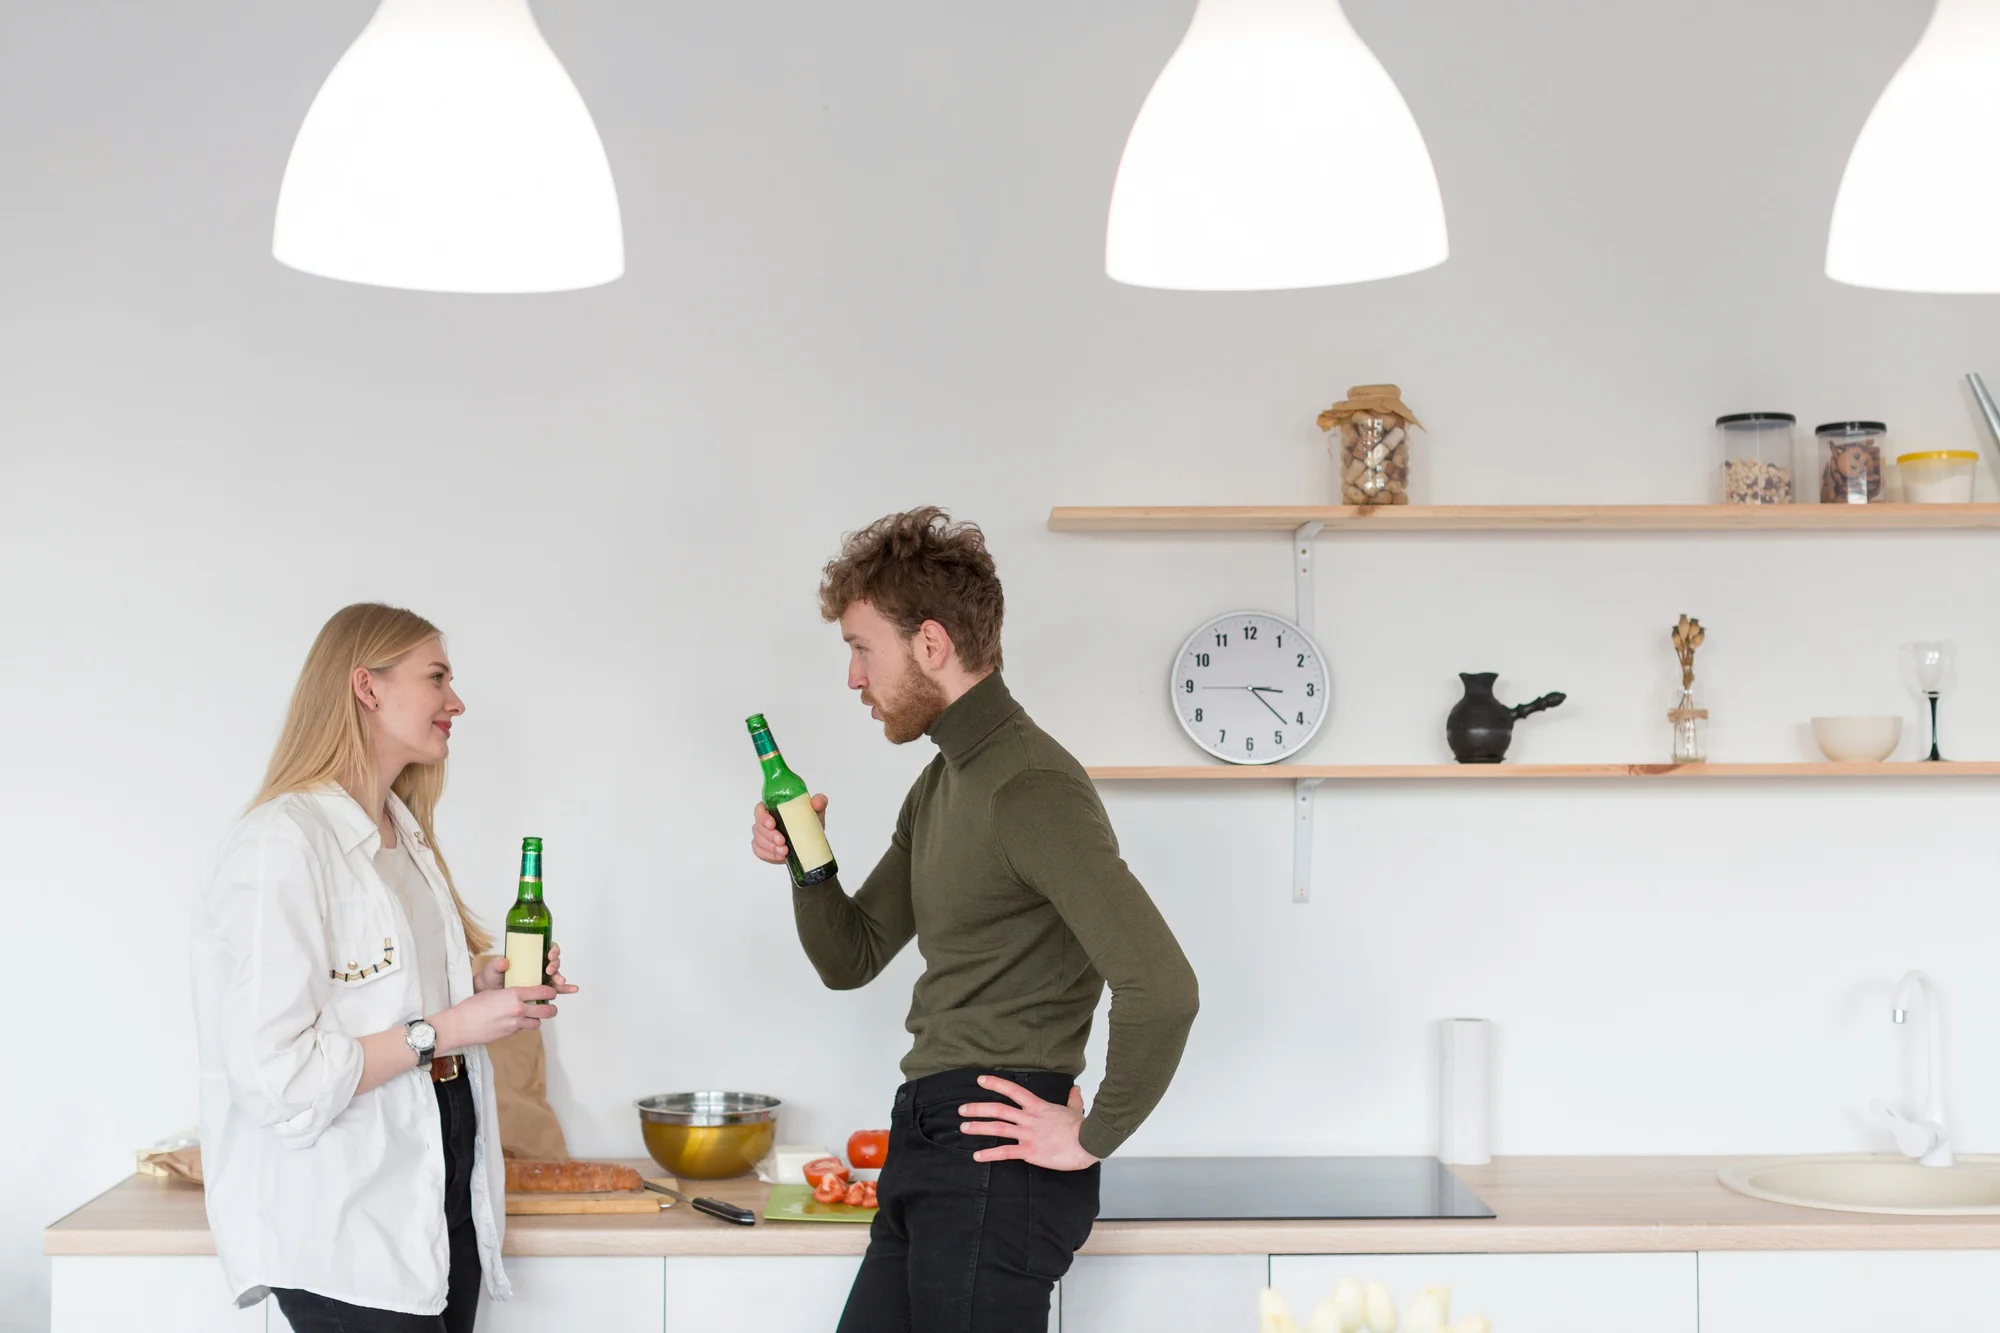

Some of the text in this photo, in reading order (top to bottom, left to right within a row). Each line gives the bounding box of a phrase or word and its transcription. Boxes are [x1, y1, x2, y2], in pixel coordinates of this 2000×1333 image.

[1215, 633, 1227, 647] 11
[1243, 626, 1257, 640] 12
[1276, 635, 1281, 648] 1
[1195, 653, 1210, 667] 10
[1297, 654, 1304, 667] 2
[1186, 679, 1194, 693] 9
[1307, 683, 1314, 697] 3
[1195, 708, 1203, 722] 8
[1296, 711, 1303, 725] 4
[1219, 729, 1226, 743] 7
[1275, 730, 1282, 744] 5
[1246, 737, 1253, 751] 6
